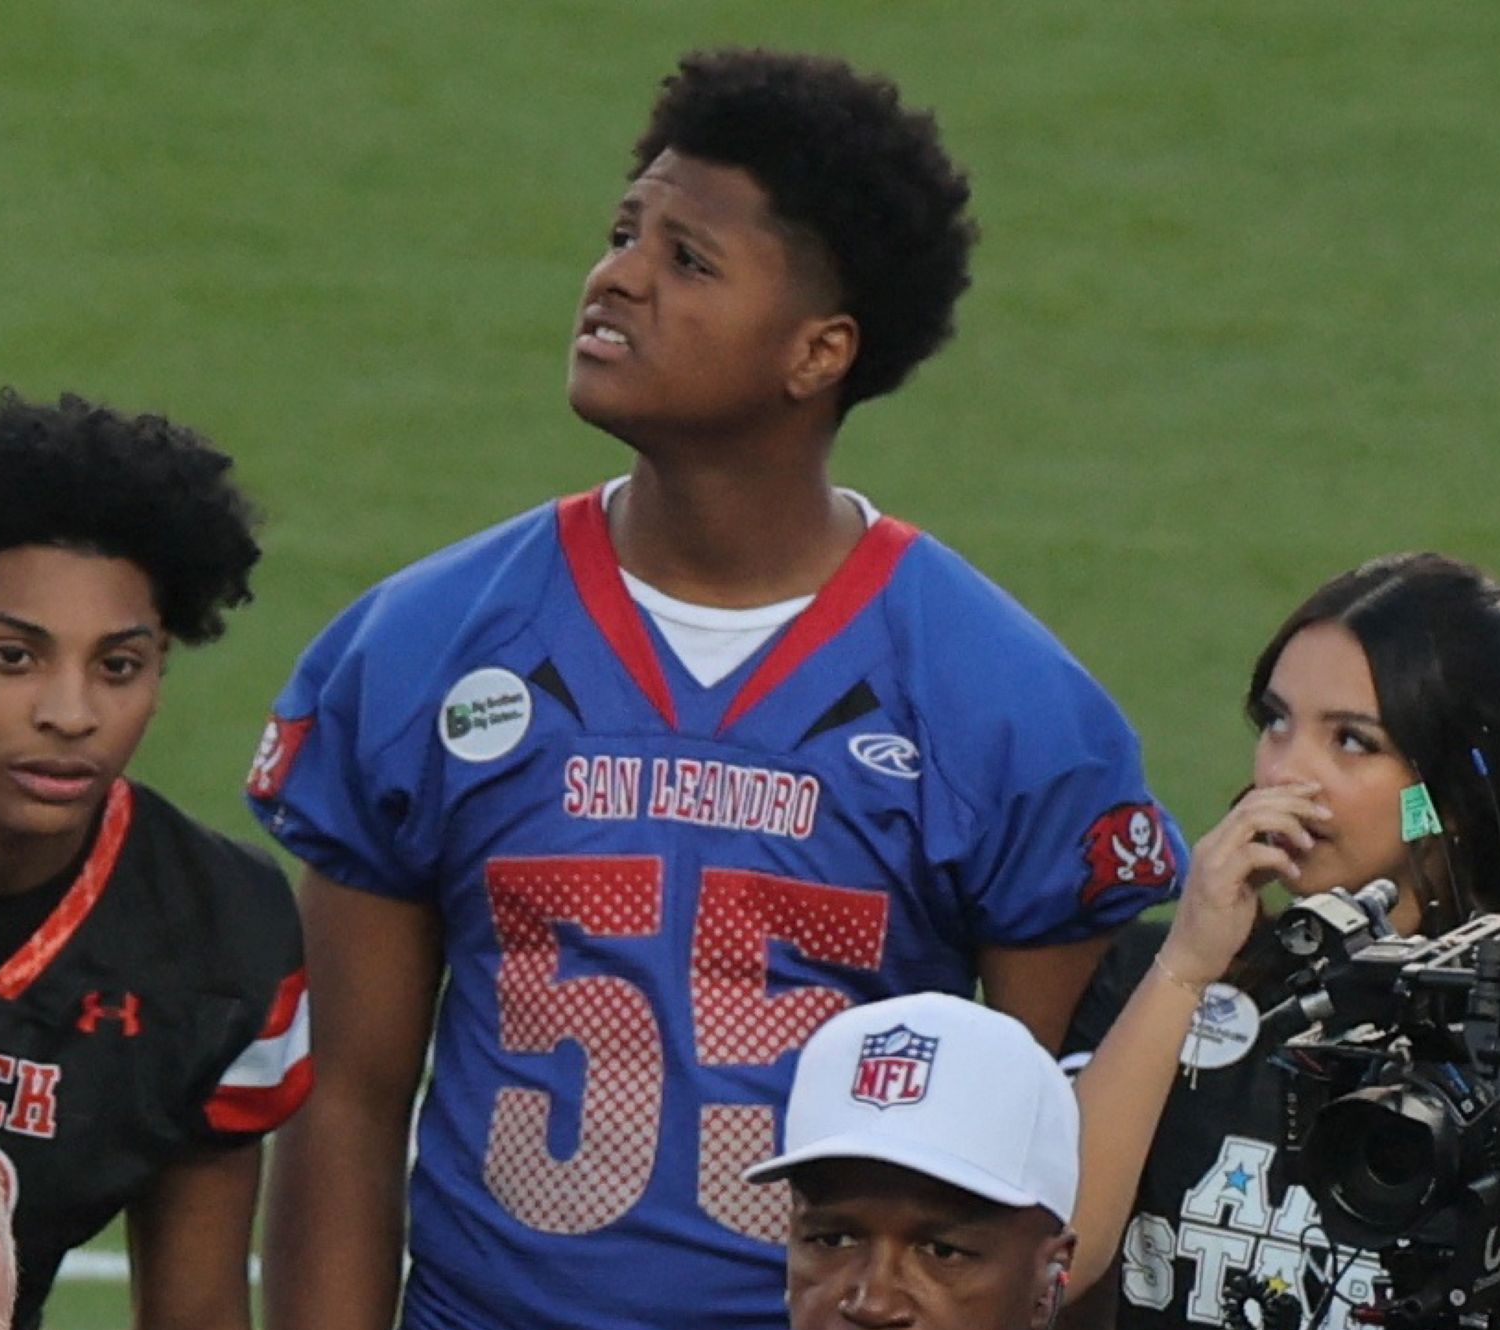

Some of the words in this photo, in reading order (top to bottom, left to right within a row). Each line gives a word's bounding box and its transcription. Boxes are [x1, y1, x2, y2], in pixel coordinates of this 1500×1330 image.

[563, 755, 642, 820] SAN
[648, 757, 821, 840] LEANDRO
[482, 855, 889, 1243] 55
[854, 1058, 921, 1103] NFL
